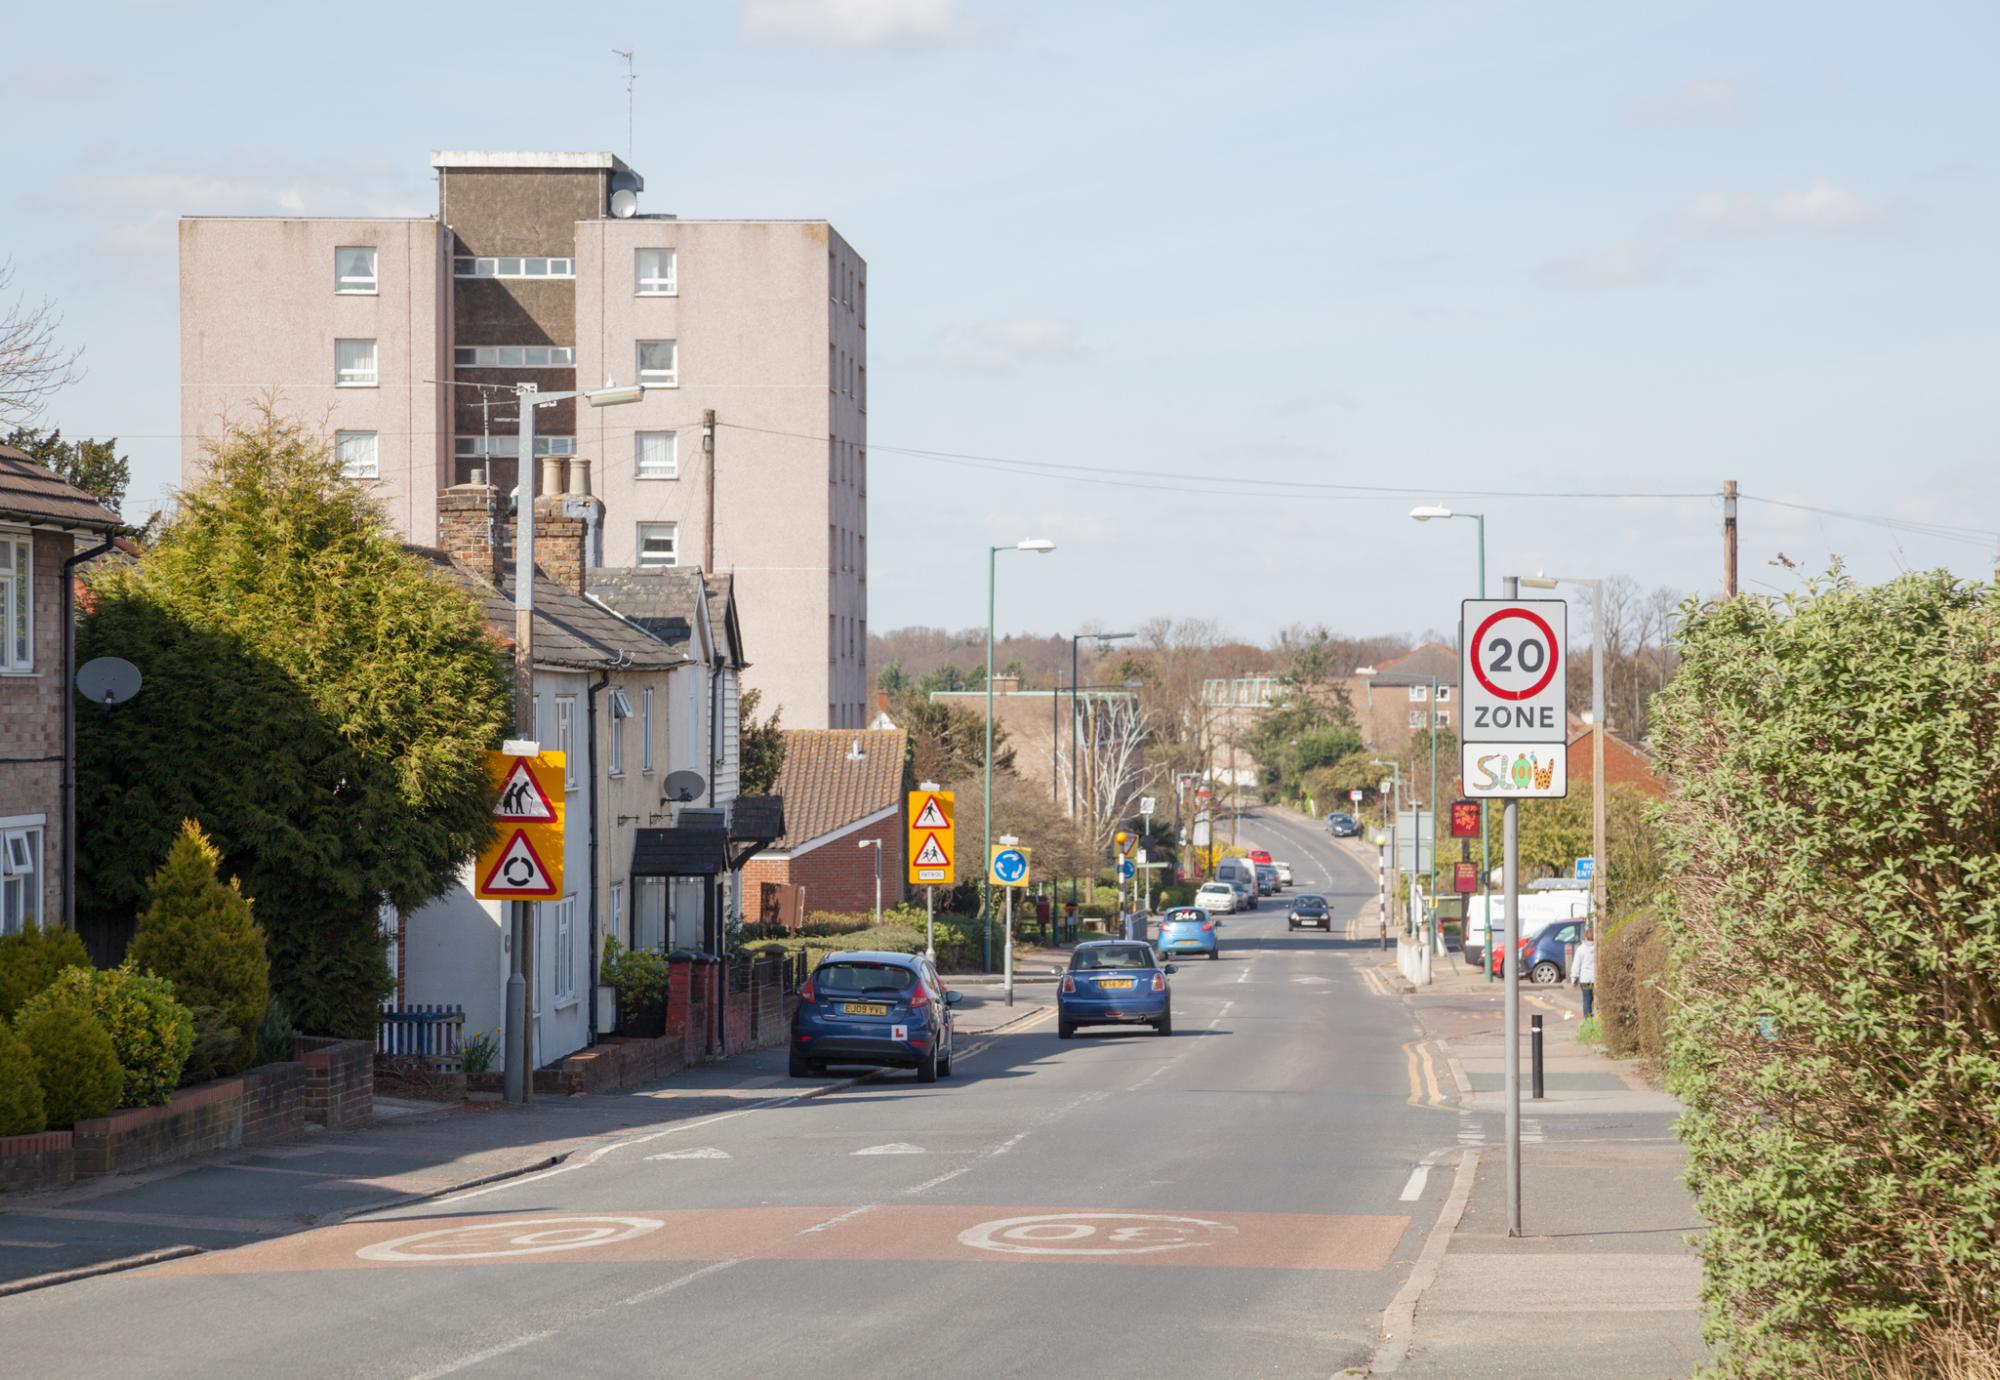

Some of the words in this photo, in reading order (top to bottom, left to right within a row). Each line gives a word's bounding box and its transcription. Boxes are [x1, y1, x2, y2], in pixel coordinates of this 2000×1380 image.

[1488, 638, 1545, 673] 20
[1474, 706, 1554, 728] ZONE
[1473, 752, 1554, 790] SLOW
[1583, 862, 1594, 870] NO
[1175, 912, 1197, 921] 244
[895, 1028, 904, 1038] L
